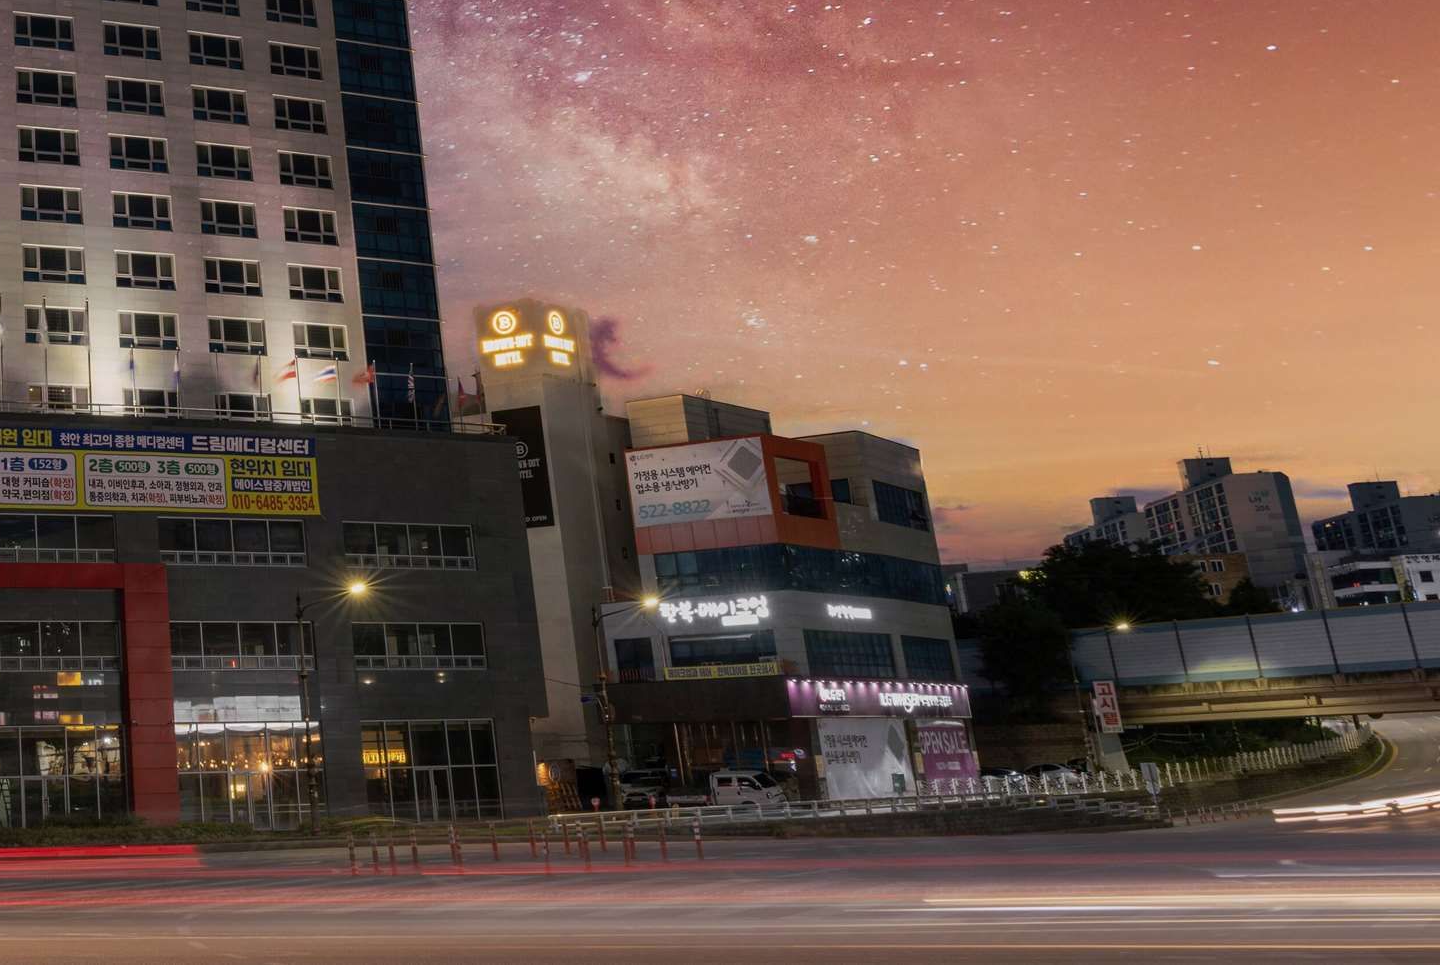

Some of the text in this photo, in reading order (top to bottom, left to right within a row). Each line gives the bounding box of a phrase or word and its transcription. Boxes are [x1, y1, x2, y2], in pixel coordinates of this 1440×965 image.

[22, 429, 53, 447] 임대
[59, 432, 80, 447] 천안
[82, 433, 113, 448] 최고의
[114, 435, 135, 448] 종합
[137, 436, 185, 450] 메디컬센터
[191, 435, 310, 455] 드림메디컬센터
[1, 457, 25, 472] 1층
[89, 459, 113, 473] 2층
[157, 460, 181, 475] 3층
[229, 459, 311, 477] 현위치 임대
[2, 476, 20, 488] 대형
[231, 494, 315, 511] 010-6485-3354
[638, 499, 712, 520] 522-8822
[918, 730, 970, 755] OPEN SALE
